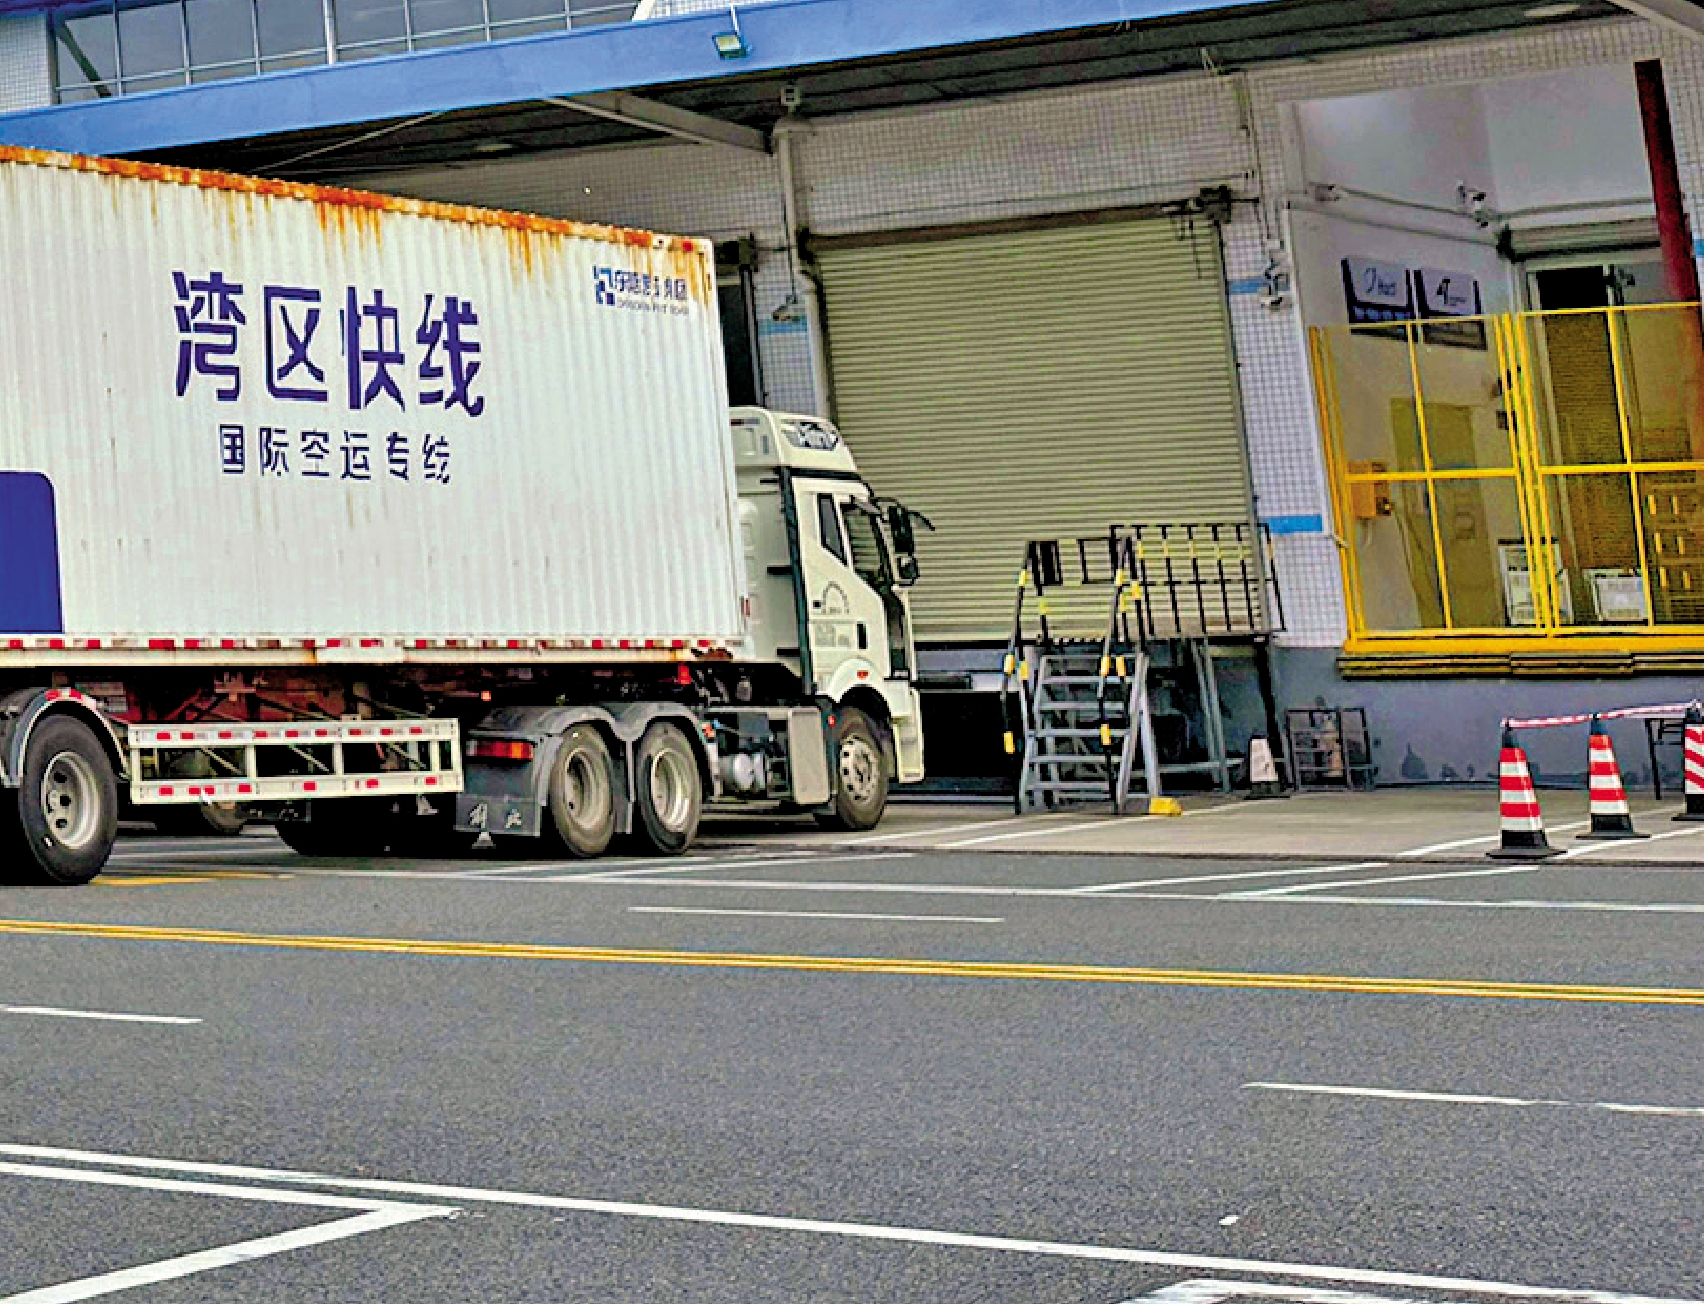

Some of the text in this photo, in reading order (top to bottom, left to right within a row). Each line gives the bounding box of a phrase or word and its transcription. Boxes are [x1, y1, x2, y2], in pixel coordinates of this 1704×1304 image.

[171, 271, 485, 418] 湾区快线
[219, 423, 451, 484] 国际空运专线
